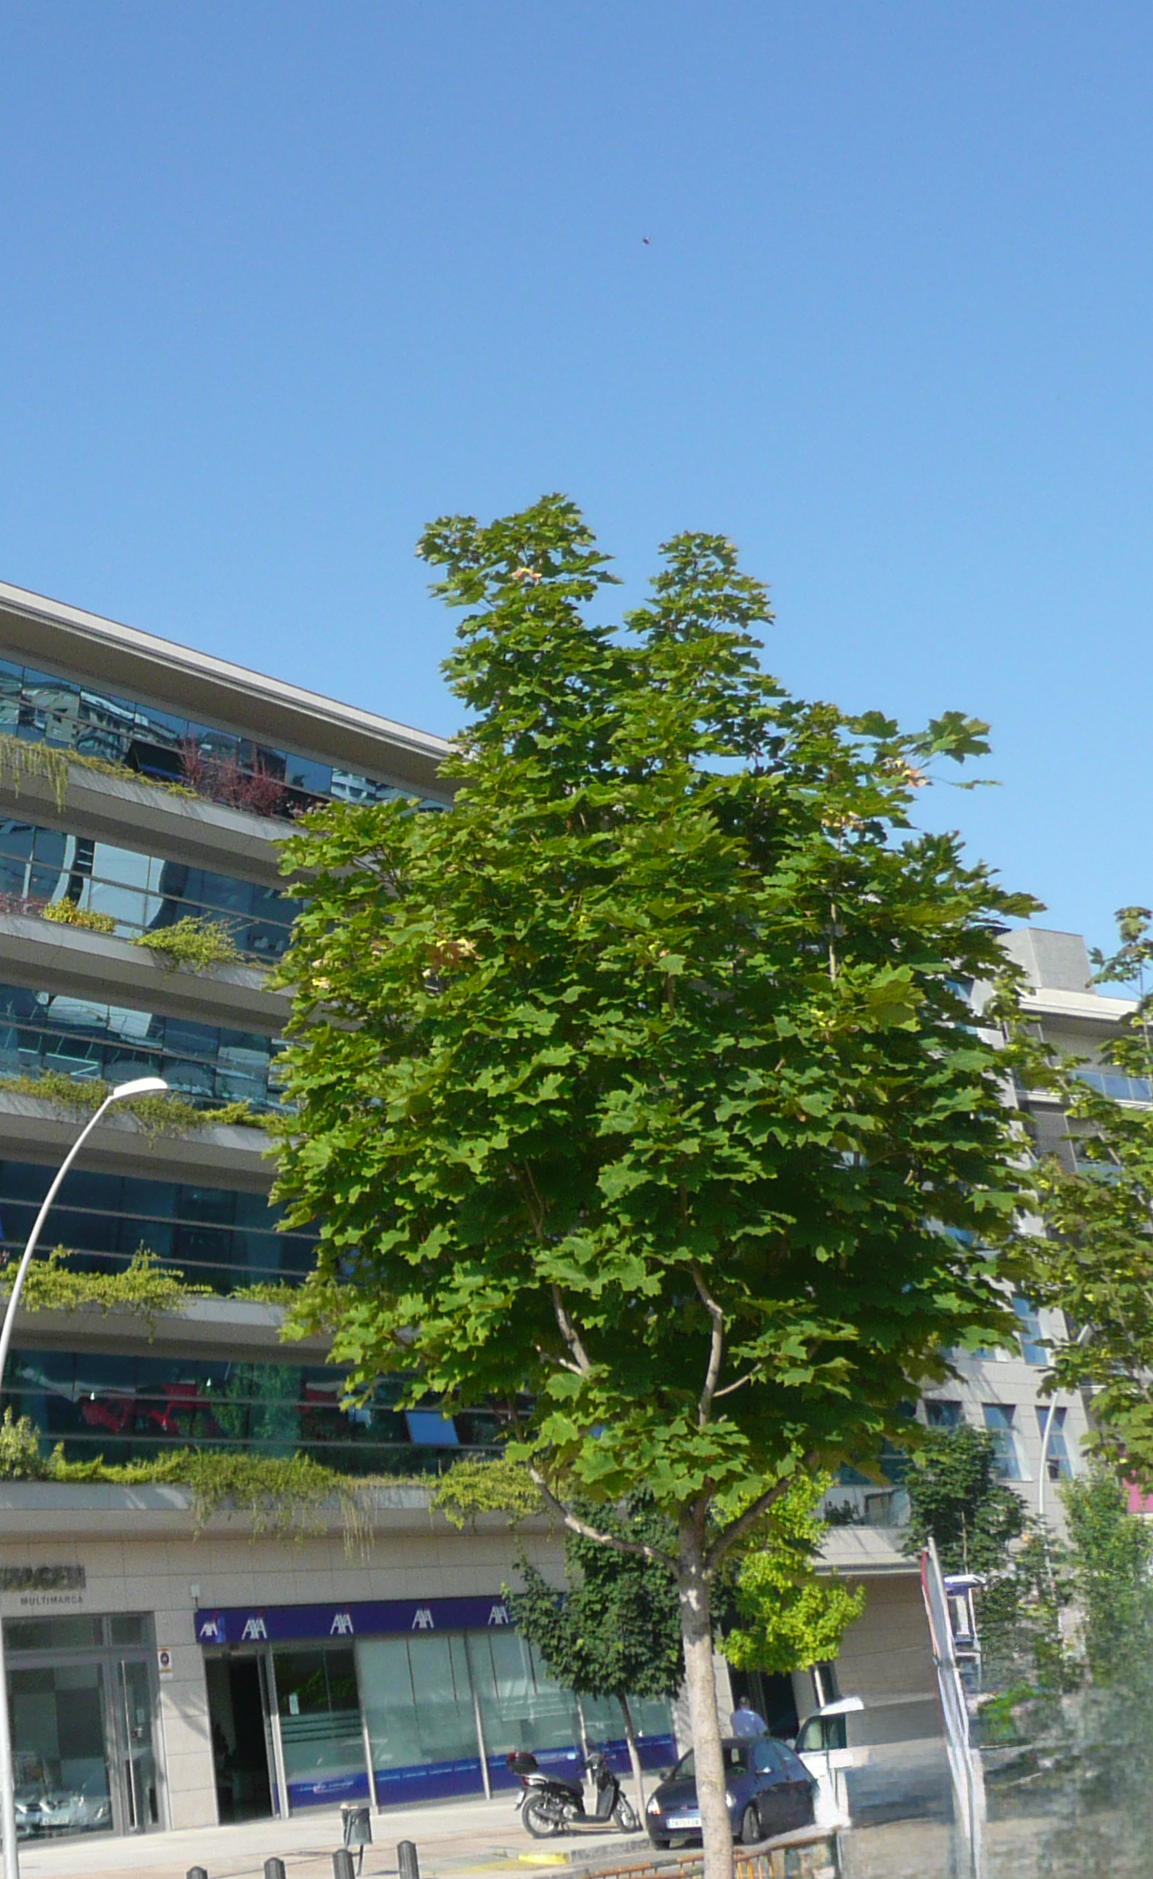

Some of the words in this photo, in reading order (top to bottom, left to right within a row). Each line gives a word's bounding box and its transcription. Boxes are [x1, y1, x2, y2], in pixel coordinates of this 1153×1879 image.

[20, 1595, 84, 1606] MULTIMARCA
[330, 1613, 354, 1635] AXA
[412, 1608, 434, 1630] AXA
[488, 1605, 508, 1625] AXA
[241, 1618, 267, 1640] AXA
